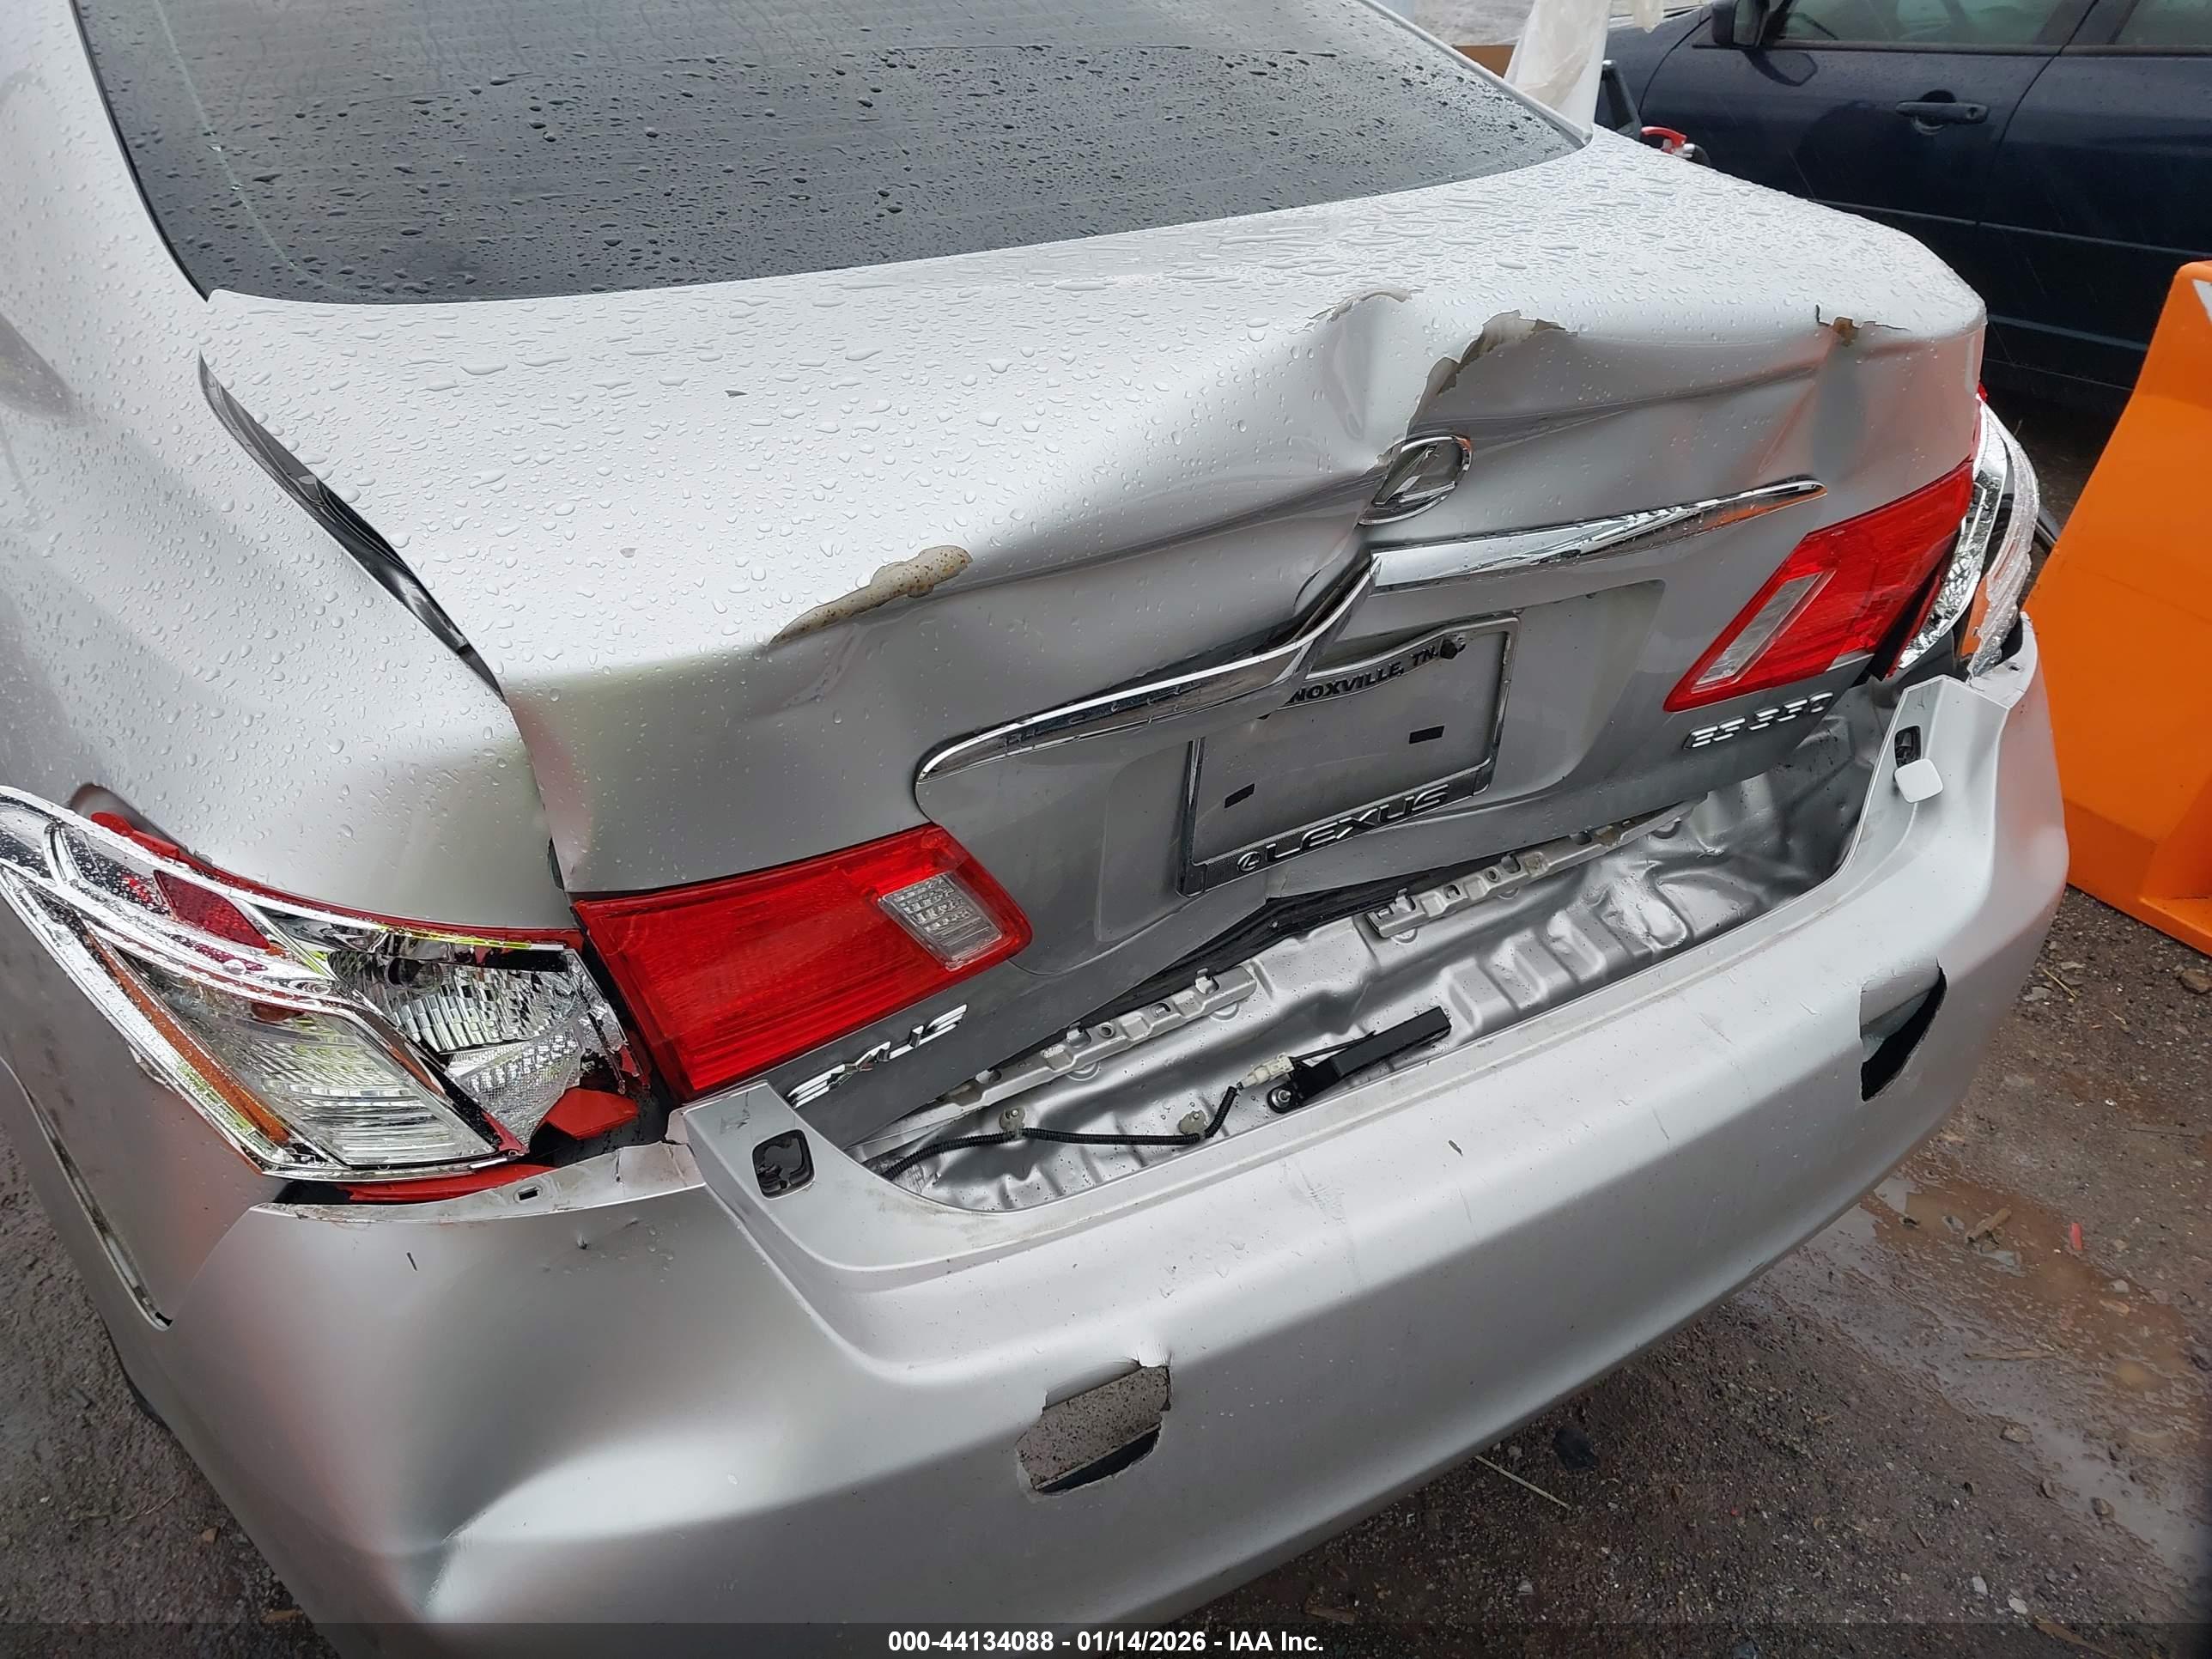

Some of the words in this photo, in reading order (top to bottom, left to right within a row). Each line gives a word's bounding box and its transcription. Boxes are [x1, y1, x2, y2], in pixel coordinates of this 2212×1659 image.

[1285, 661, 1405, 705] NOXVILLE,
[1684, 717, 1746, 749] ES
[1748, 692, 1834, 731] 350
[1265, 784, 1449, 862] LEXUS
[785, 1004, 968, 1109] EXUS
